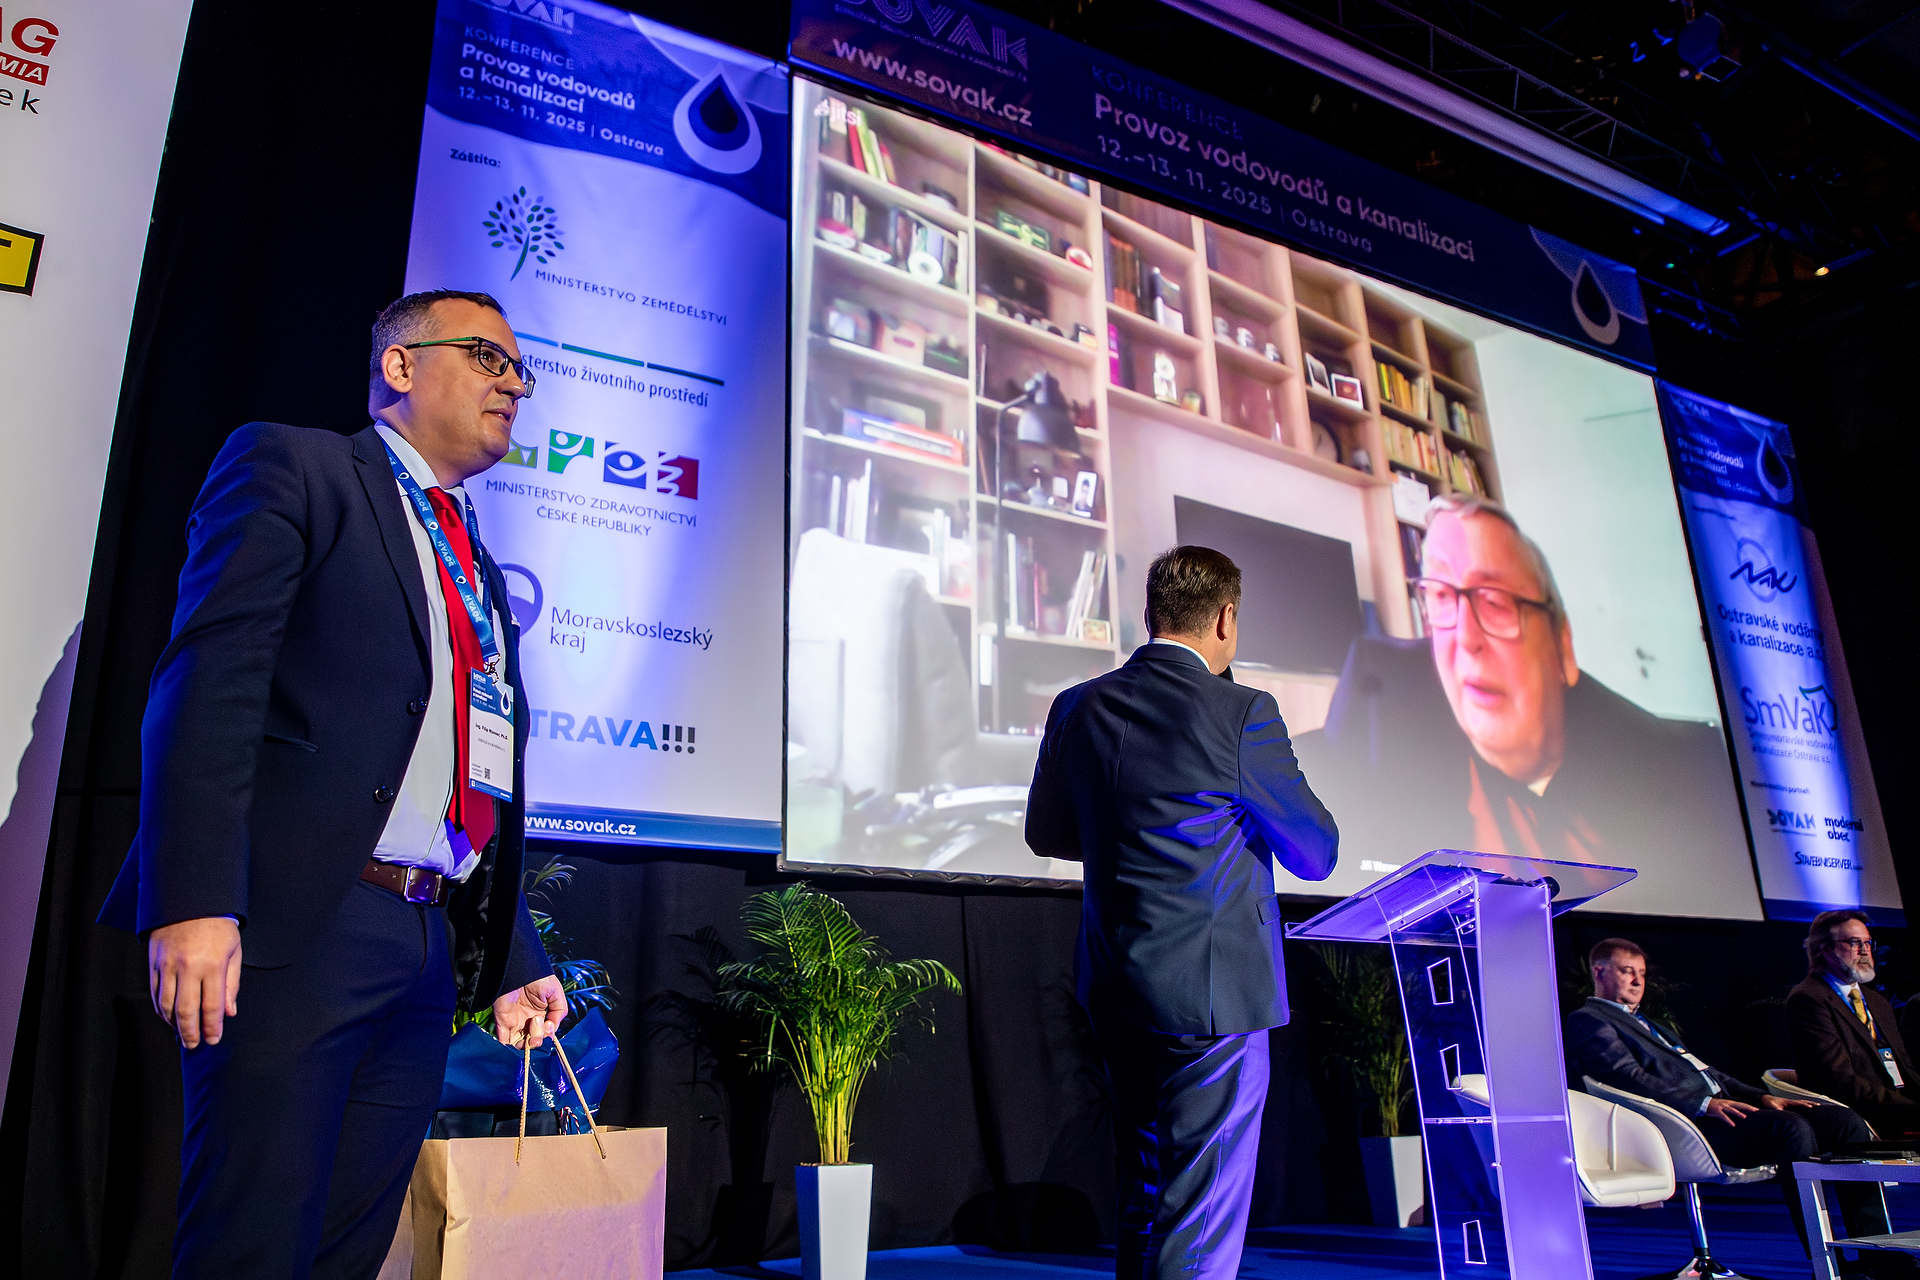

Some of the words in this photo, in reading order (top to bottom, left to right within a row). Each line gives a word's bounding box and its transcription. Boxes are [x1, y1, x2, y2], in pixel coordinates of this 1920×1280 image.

[0, 7, 60, 57] G
[464, 25, 576, 71] KONFERENCE
[842, 0, 1028, 70] OVAK
[0, 55, 43, 82] MIA
[459, 65, 474, 80] a
[481, 63, 585, 114] kanalizací
[462, 42, 530, 77] Provoz
[535, 68, 636, 112] vodovodů
[833, 38, 1032, 127] www.sovak.cz
[0, 88, 40, 115] ek
[1091, 64, 1244, 140] KONFERENCE
[521, 104, 541, 121] 11.
[545, 111, 586, 134] 2025
[600, 127, 665, 157] Ostrava
[450, 148, 502, 169] Záštita:
[1095, 92, 1191, 152] Provoz
[1198, 139, 1329, 206] vodovodů
[1336, 196, 1352, 215] a
[1358, 197, 1475, 263] kanalizací
[1187, 170, 1212, 193] 11.
[1220, 180, 1272, 216] 2025
[1293, 208, 1373, 253] Ostrava
[535, 269, 637, 303] MINISTERSTVO
[642, 295, 728, 326] ZEMĚDĚLSTVÍ
[521, 354, 577, 378] sterstvo
[580, 365, 645, 393] životního
[649, 381, 708, 408] prostředí
[486, 479, 585, 506] MINISTERSTVO
[590, 496, 697, 527] ZDRAVOTNICTVÍ
[536, 504, 578, 525] ČESKÉ
[582, 515, 652, 537] REPUBLIKY
[549, 626, 585, 653] kraj
[551, 606, 713, 651] Moravskoslezský
[1717, 603, 1779, 632] Ostravské
[1737, 629, 1805, 656] kanalizace
[530, 708, 696, 754] TRAVA!!!
[1741, 686, 1836, 737] SmVaK
